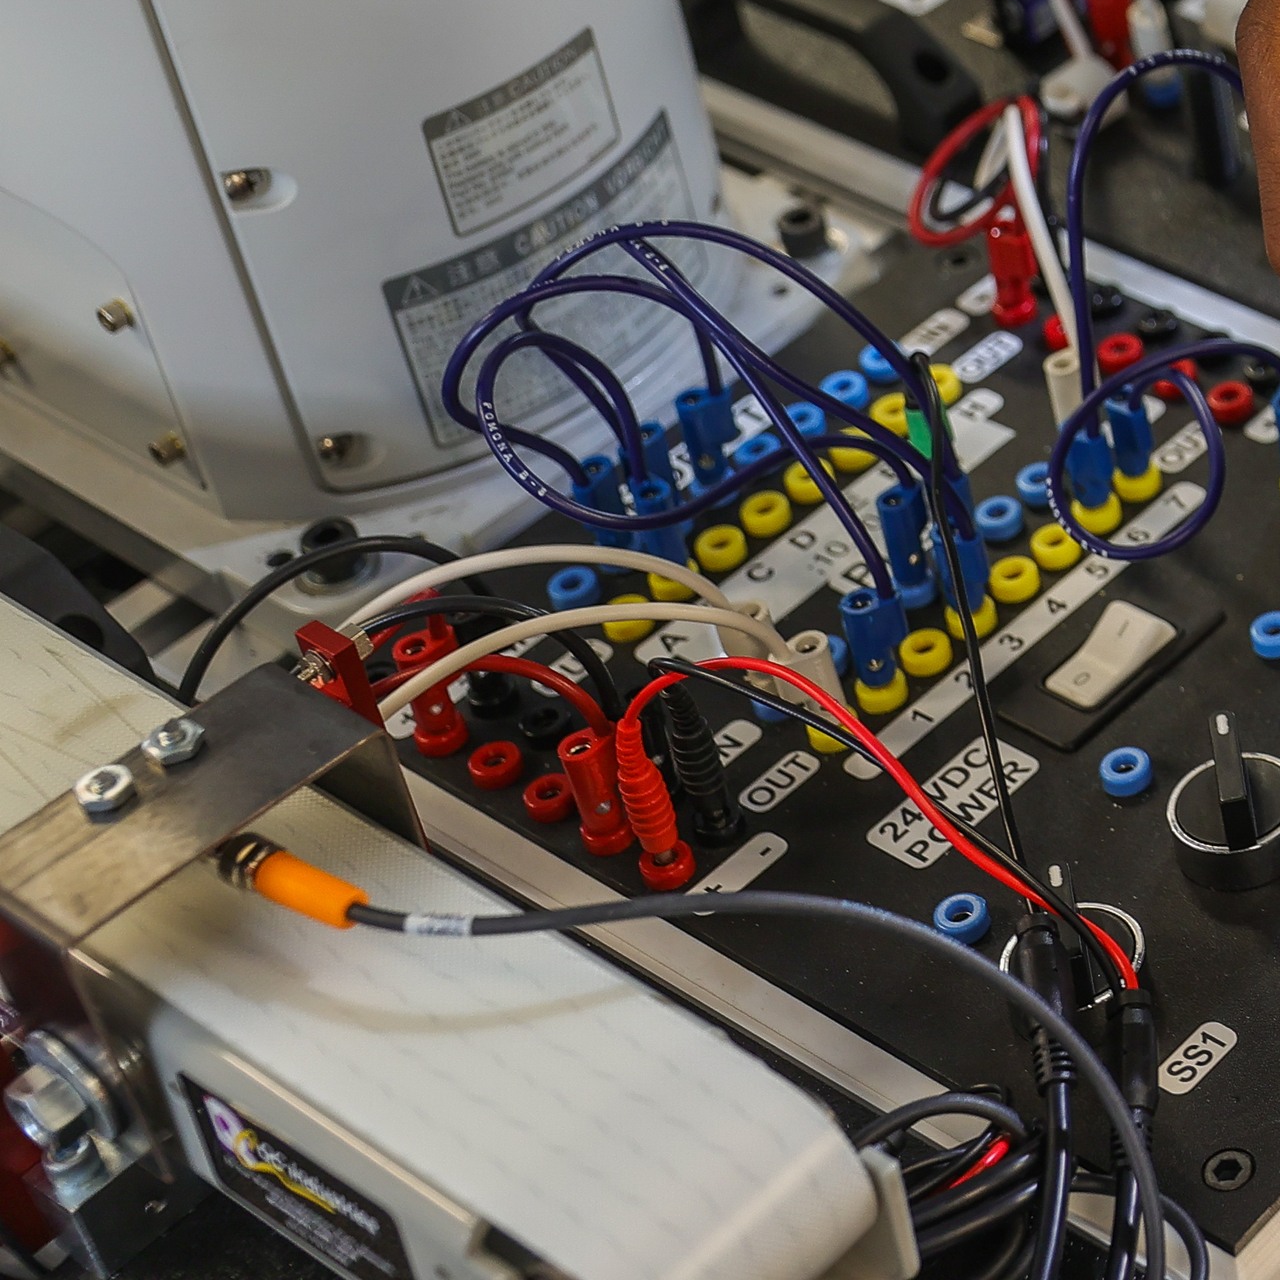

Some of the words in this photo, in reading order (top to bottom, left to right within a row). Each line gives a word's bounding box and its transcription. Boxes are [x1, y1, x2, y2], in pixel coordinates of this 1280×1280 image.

[514, 190, 601, 255] CAUTION
[482, 401, 514, 464] POMONA
[790, 530, 817, 551] D
[911, 708, 935, 723] 1
[999, 633, 1024, 652] 3
[1046, 597, 1068, 615] 4
[1085, 562, 1109, 578] 5
[1126, 528, 1150, 542] 6
[1164, 494, 1186, 510] 7
[747, 754, 811, 807] OUT
[878, 806, 924, 844] 24
[921, 747, 990, 803] VDC
[1166, 1030, 1227, 1083] SS1
